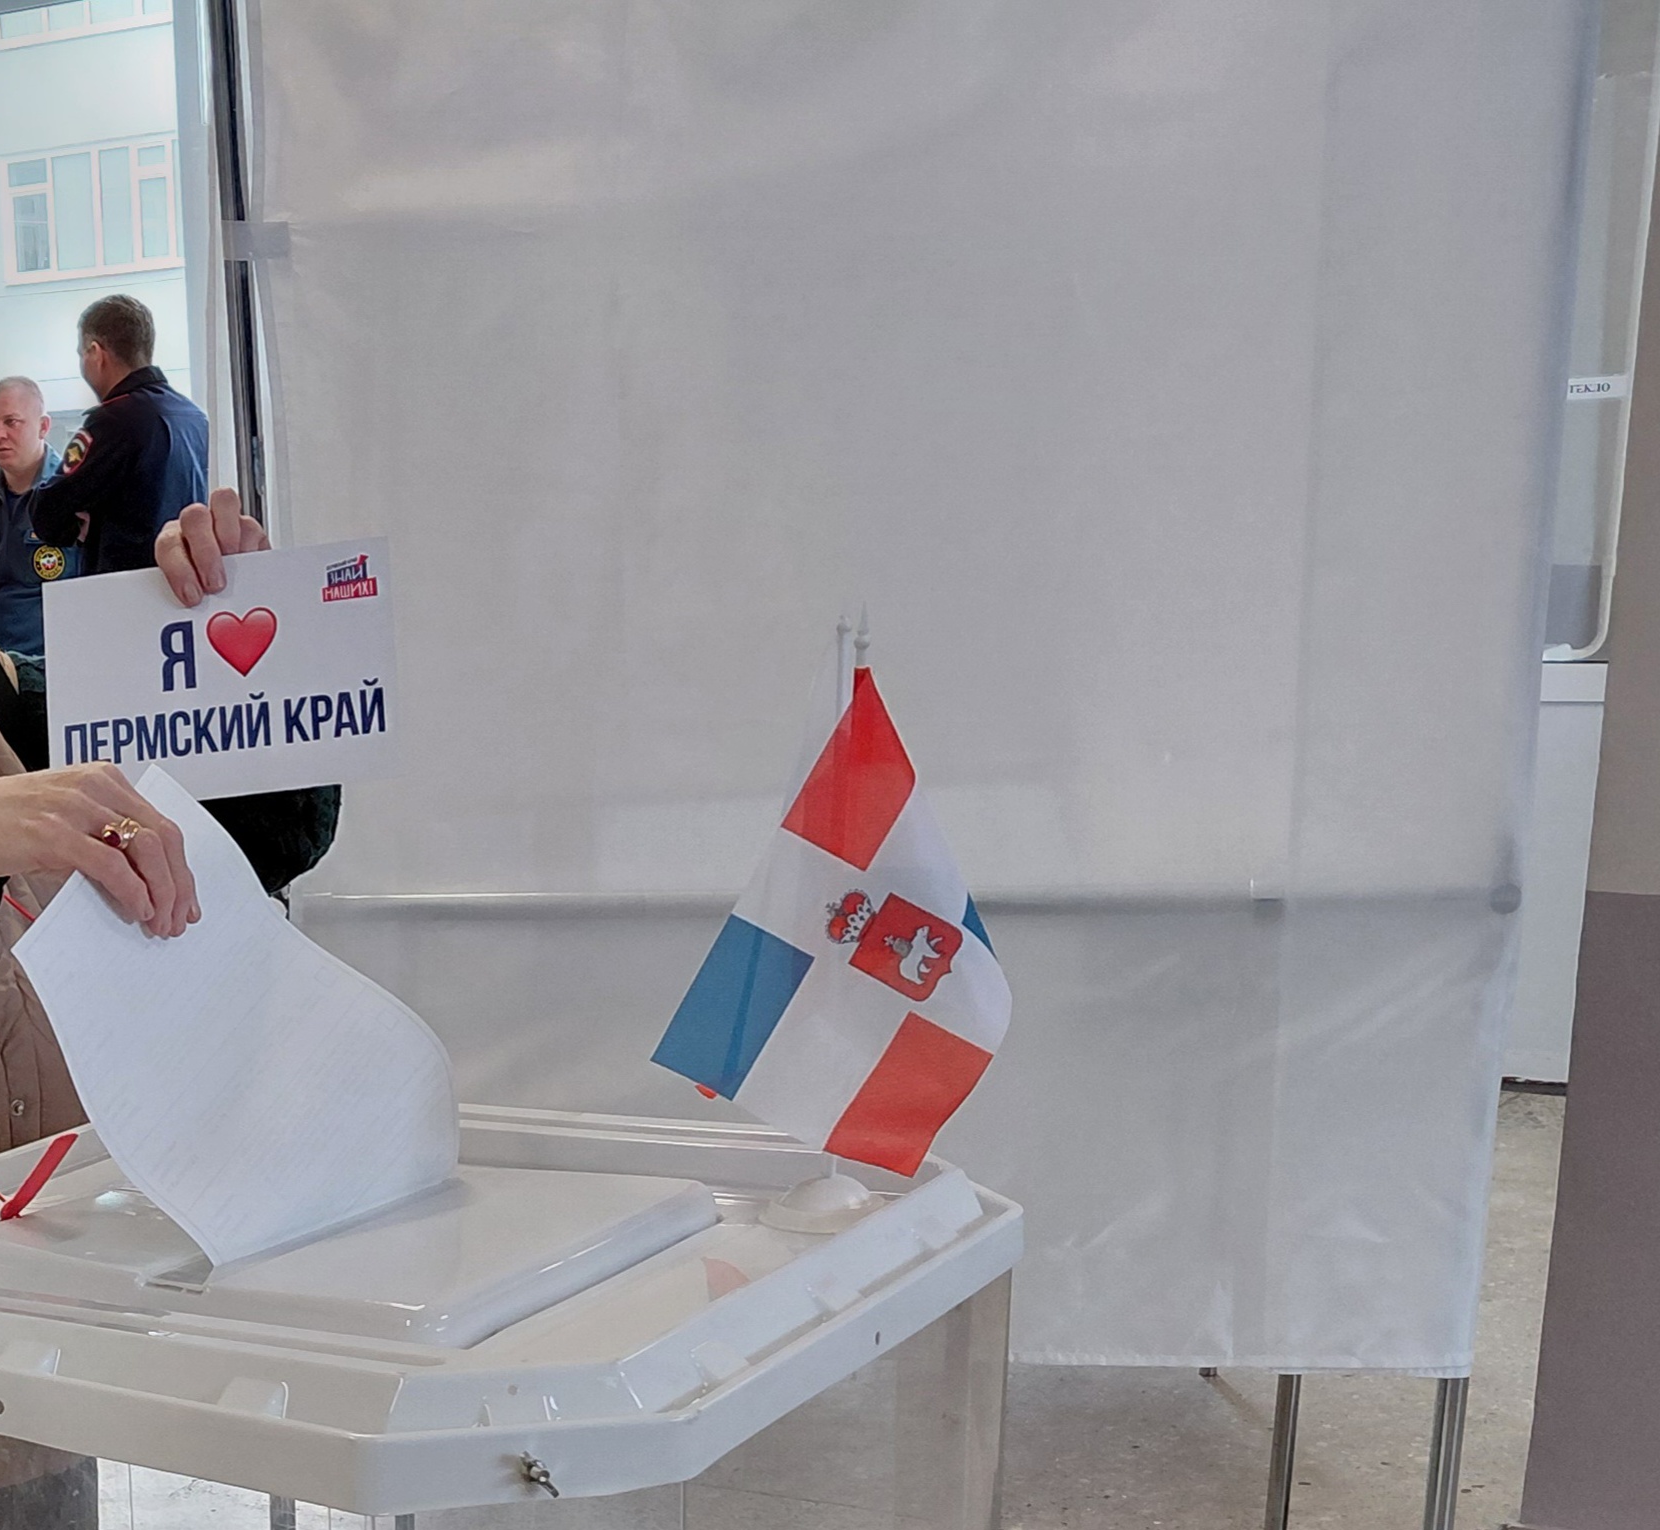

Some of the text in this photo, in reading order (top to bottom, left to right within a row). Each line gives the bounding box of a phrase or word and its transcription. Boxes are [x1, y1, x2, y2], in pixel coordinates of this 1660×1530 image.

[324, 579, 375, 601] НАШИХ!
[160, 620, 197, 692] Я
[64, 677, 386, 766] ПЕРМСКИЙ КРАЙ
